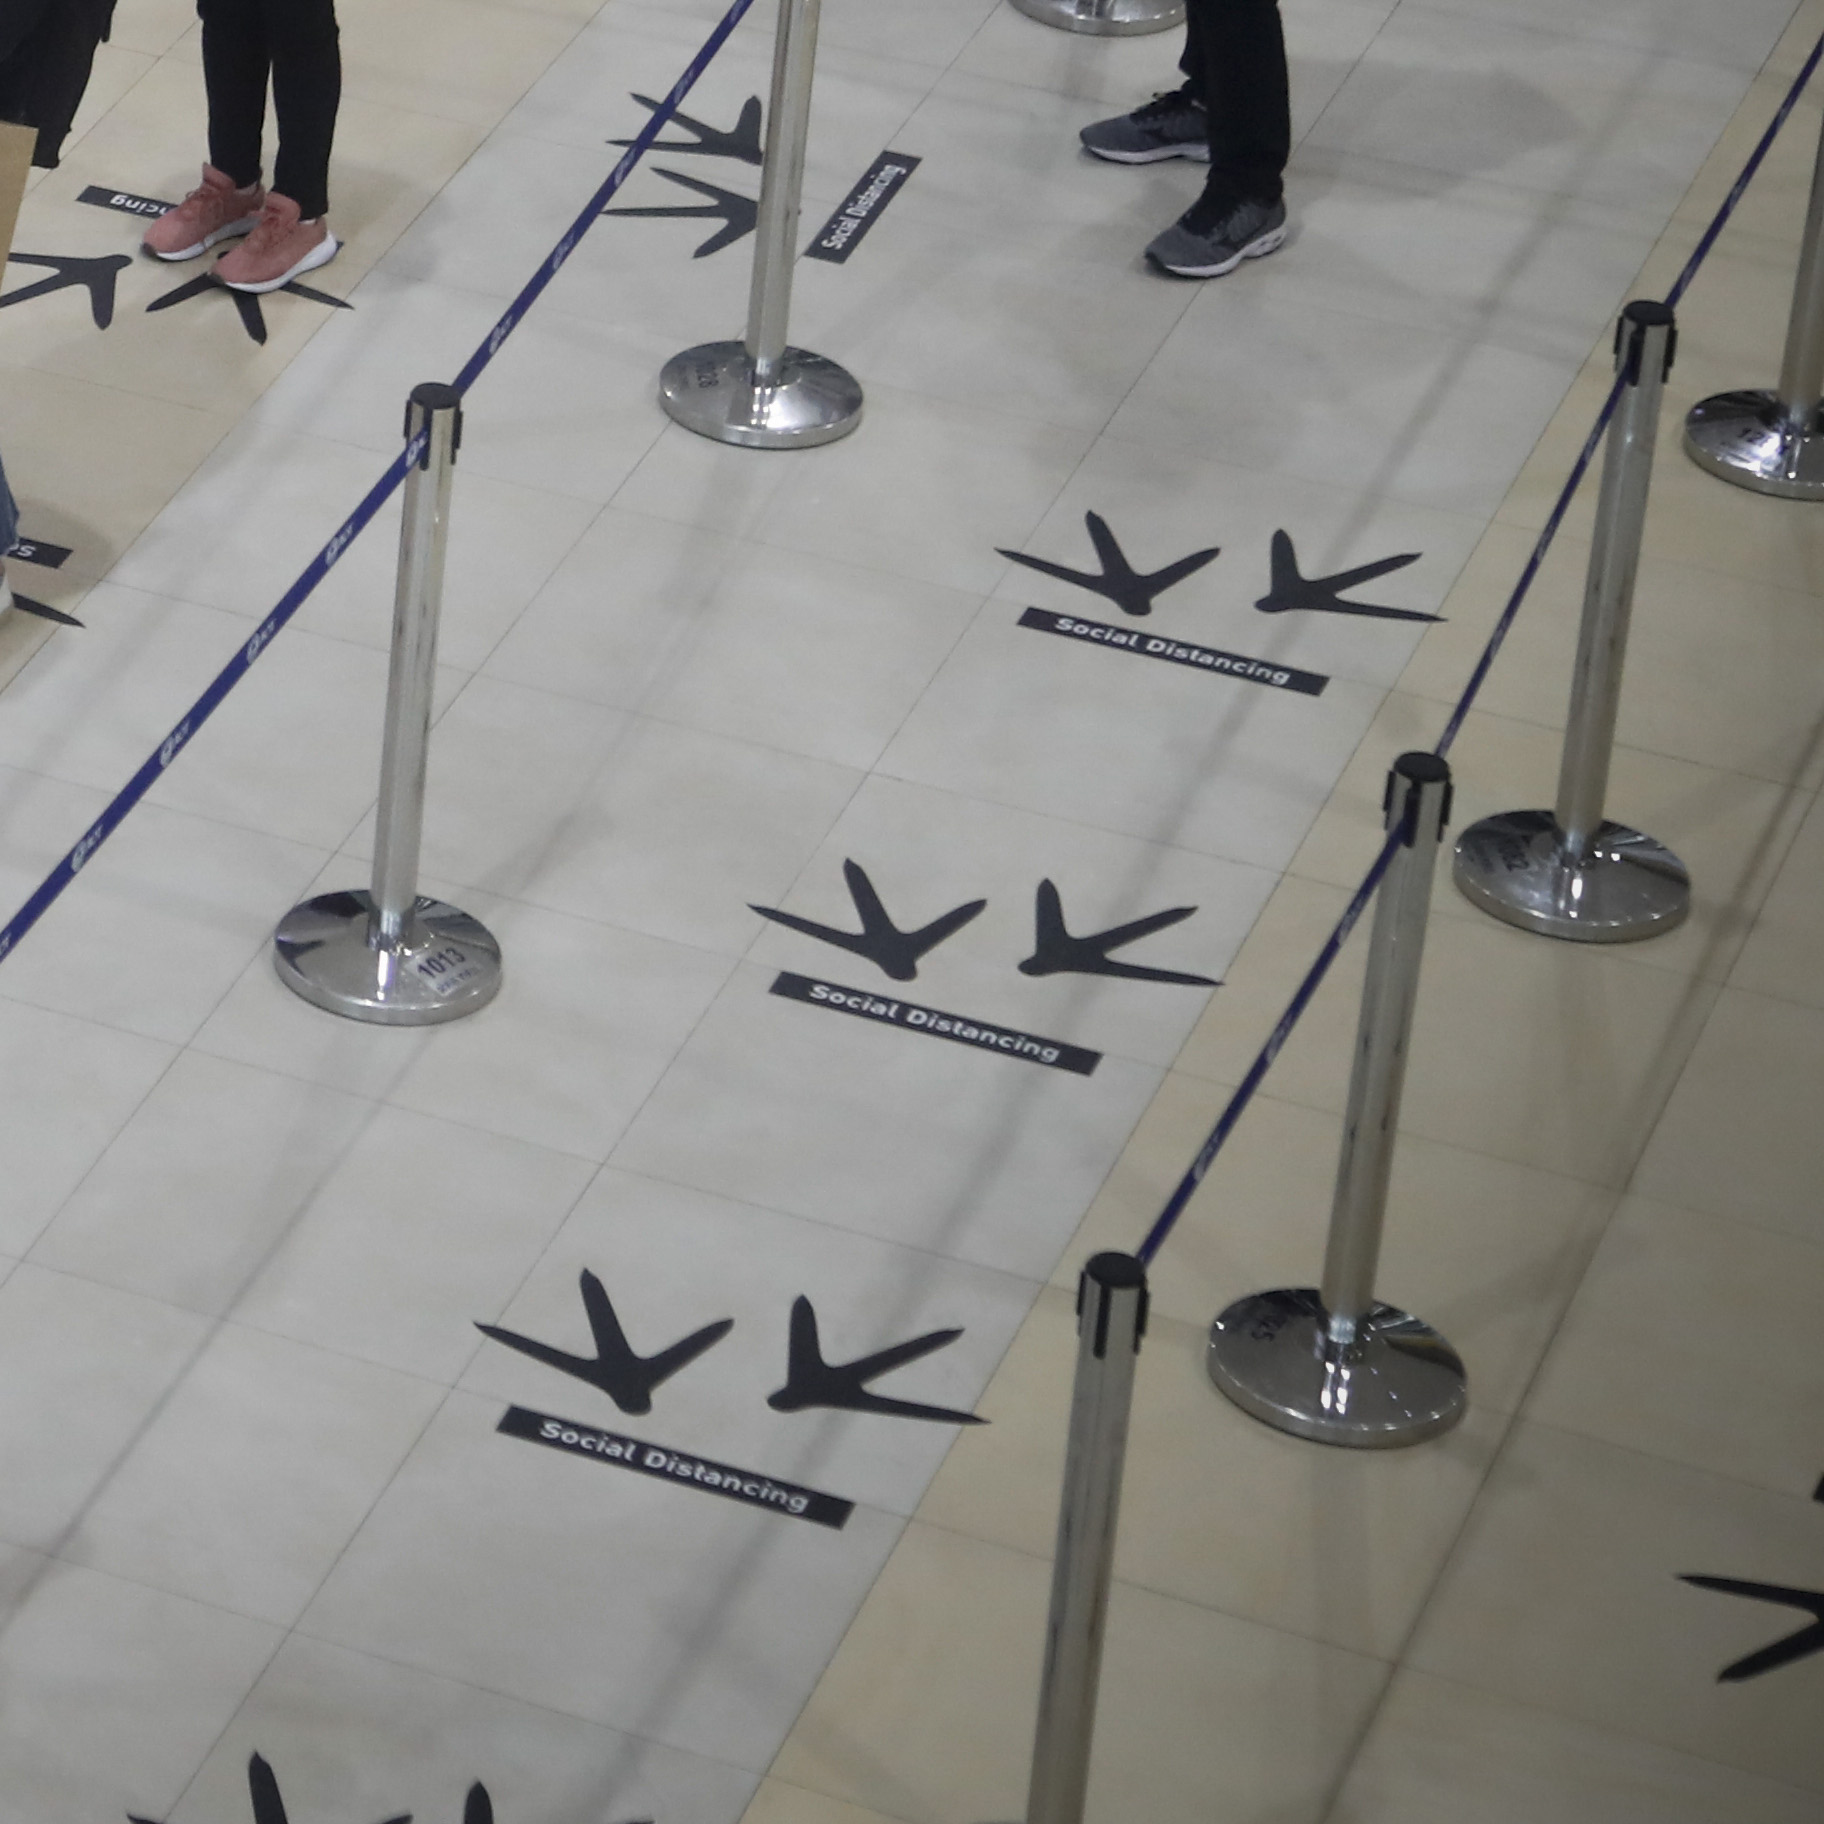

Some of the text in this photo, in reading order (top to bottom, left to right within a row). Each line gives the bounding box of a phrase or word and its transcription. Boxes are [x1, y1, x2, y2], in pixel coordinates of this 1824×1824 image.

[821, 164, 907, 250] Social Distancing
[1054, 617, 1292, 687] Social Distancing
[415, 947, 464, 978] 1013
[809, 984, 1061, 1064] Social Distancing
[539, 1419, 810, 1516] Social Distancing
